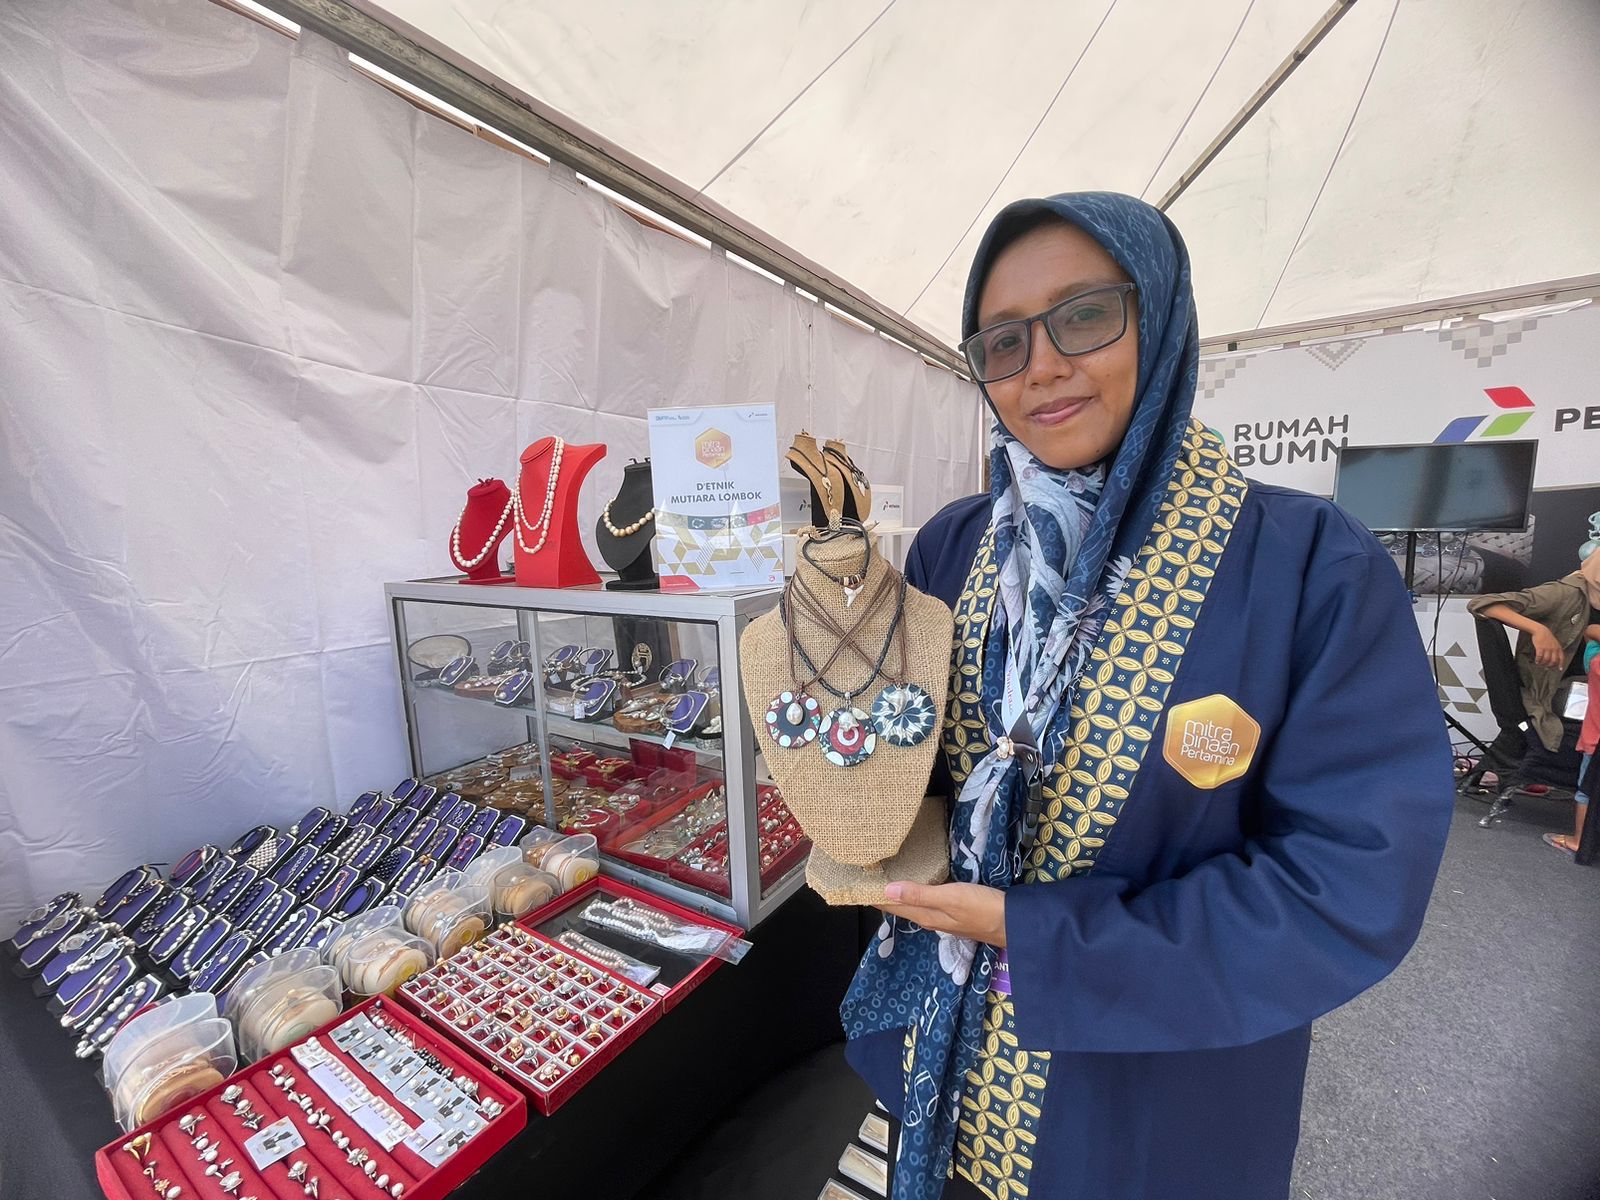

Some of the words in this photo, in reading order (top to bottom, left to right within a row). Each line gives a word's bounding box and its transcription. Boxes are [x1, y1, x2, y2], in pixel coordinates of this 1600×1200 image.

[1233, 414, 1349, 442] RUMAH
[1554, 406, 1600, 432] PE
[1233, 436, 1348, 467] BUMN
[671, 494, 716, 504] MUTIARA
[718, 491, 762, 501] LOMBOK
[696, 481, 735, 491] D'ETNIK
[1184, 719, 1233, 741] mitra
[1180, 744, 1236, 766] Pertamina
[1182, 731, 1240, 756] binaan
